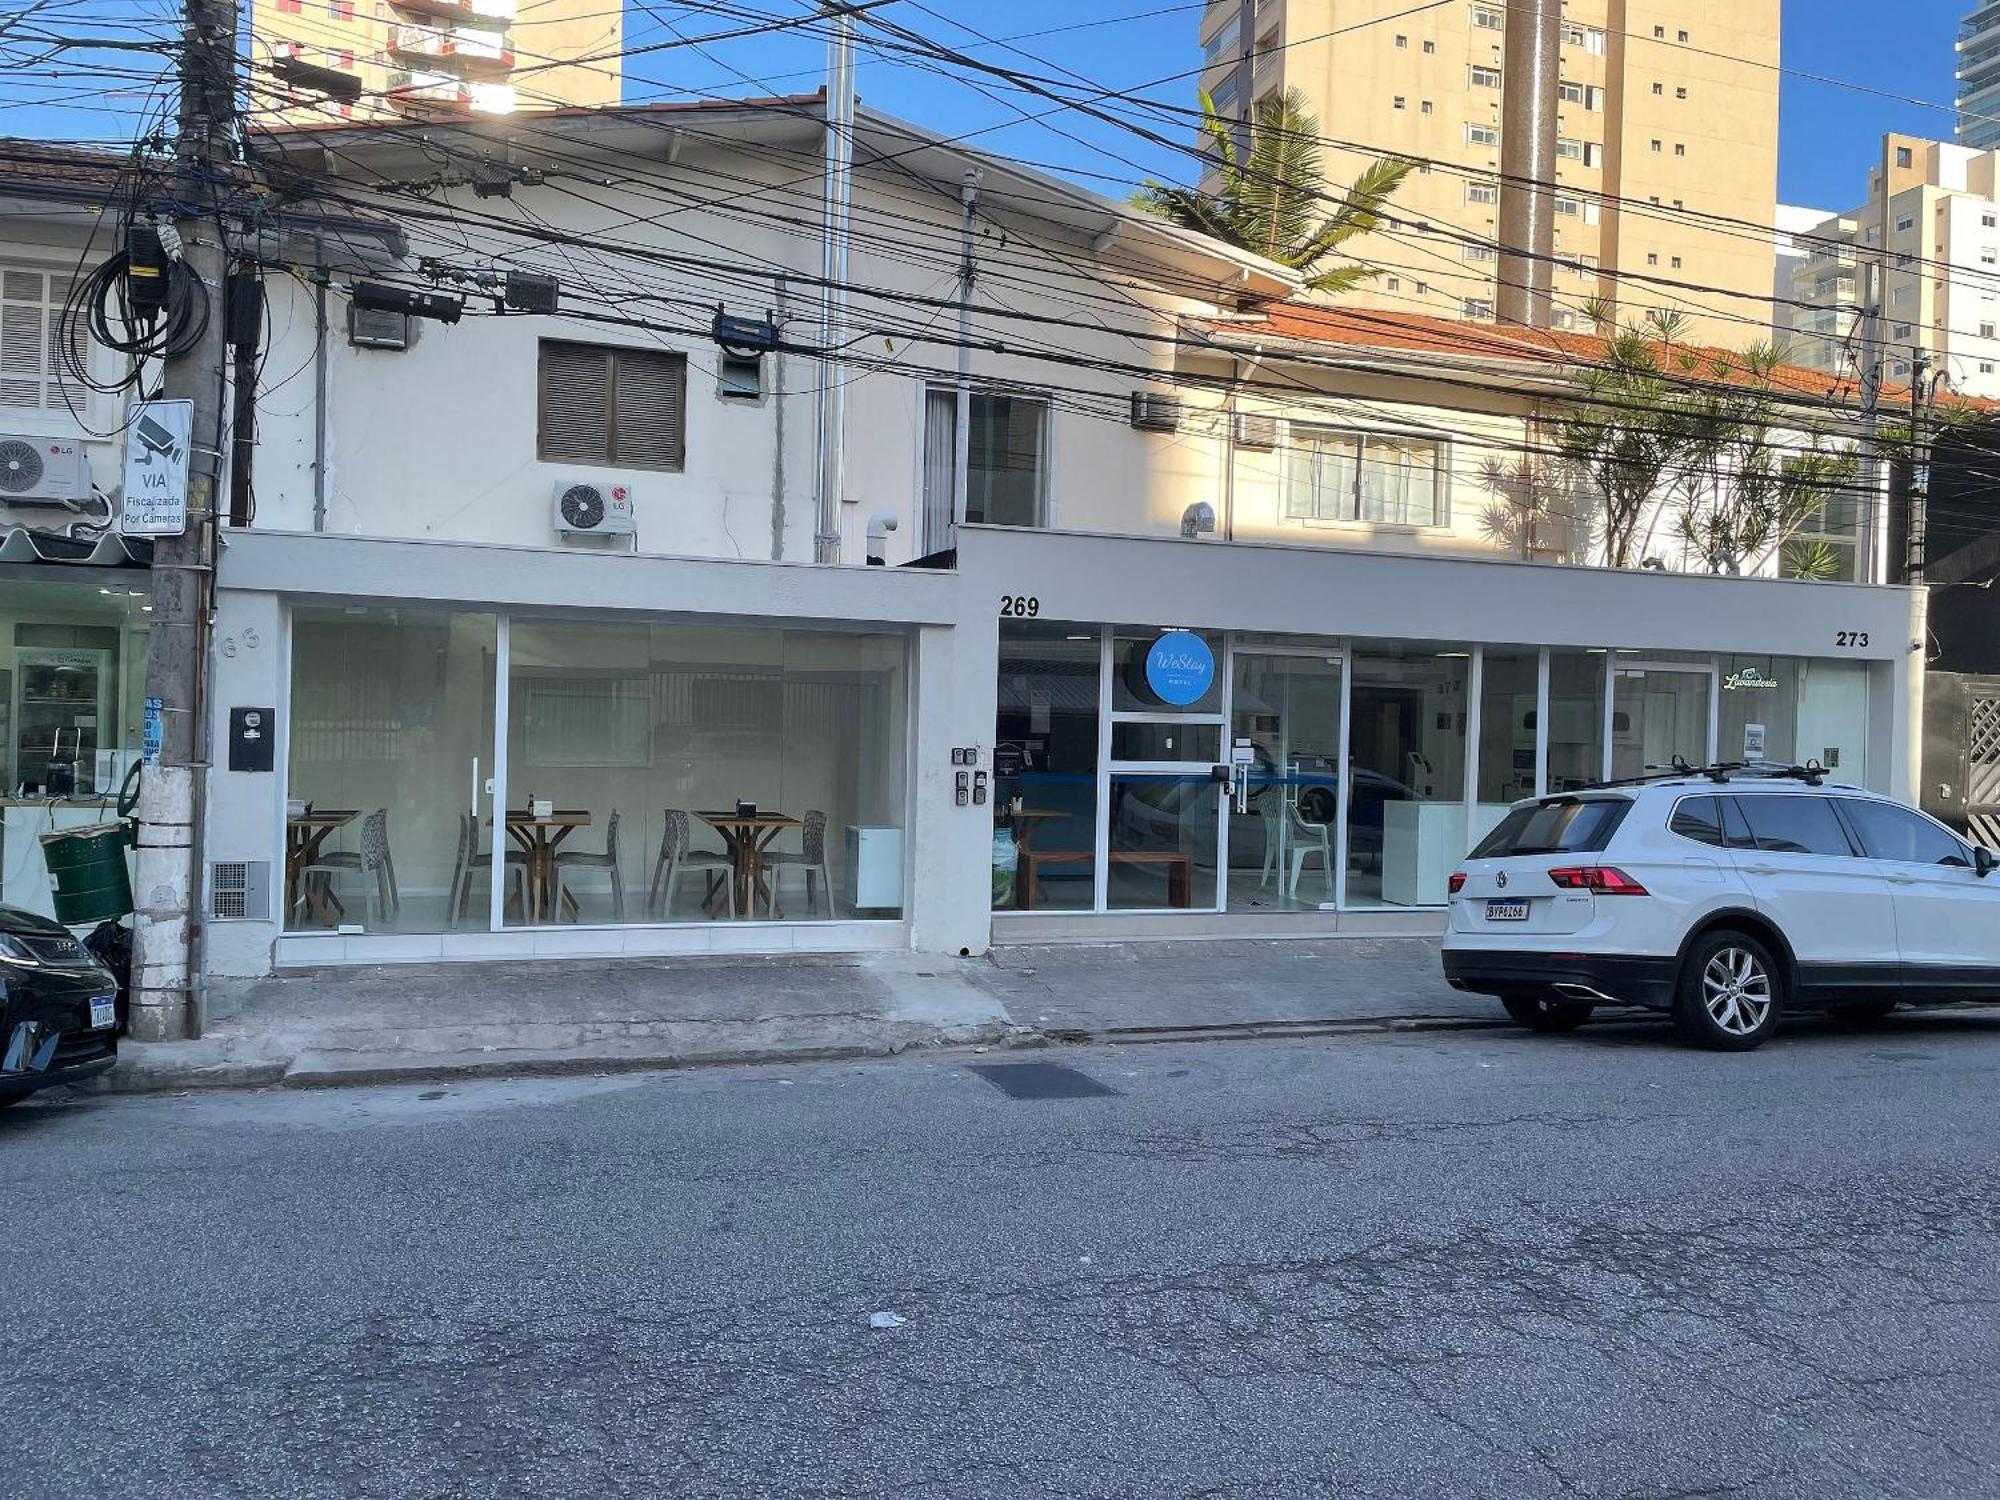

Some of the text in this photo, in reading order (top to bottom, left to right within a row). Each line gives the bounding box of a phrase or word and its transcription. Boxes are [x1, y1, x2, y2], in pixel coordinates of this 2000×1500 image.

[142, 473, 167, 488] VIA
[613, 502, 625, 510] LG
[125, 513, 140, 523] Por
[1000, 595, 1040, 617] 269
[1836, 631, 1869, 648] 273
[1156, 651, 1206, 674] WeStay
